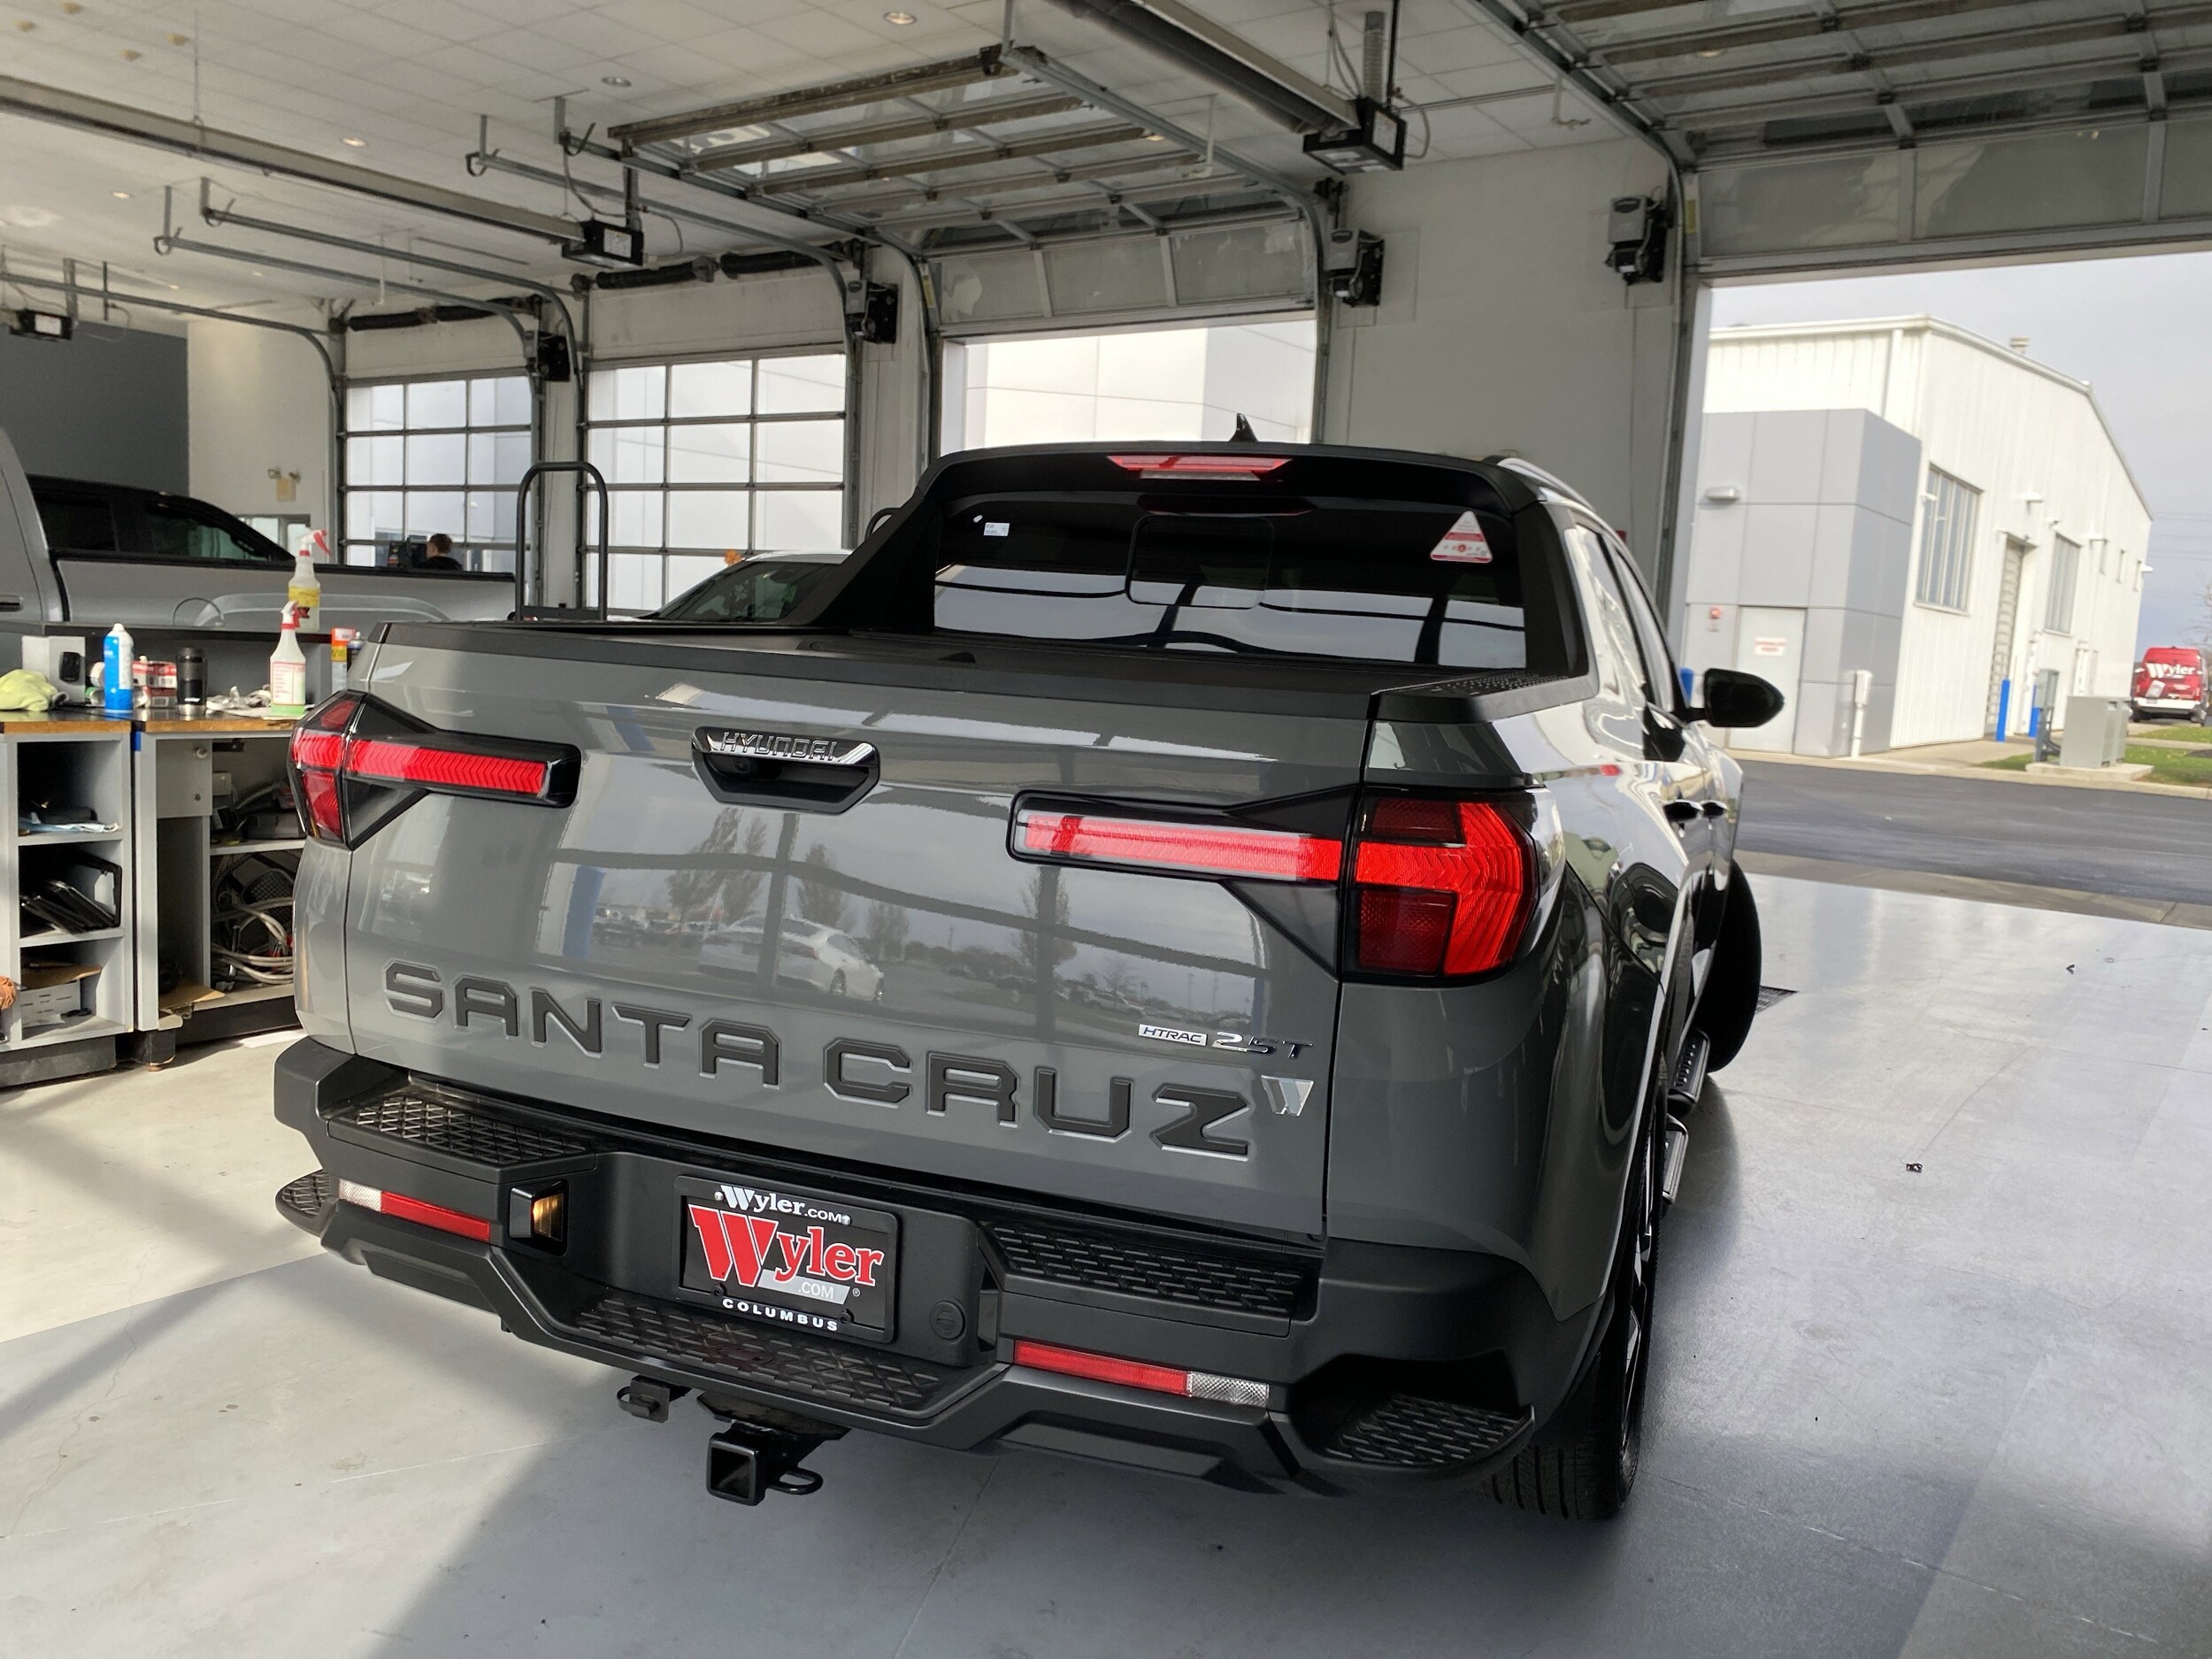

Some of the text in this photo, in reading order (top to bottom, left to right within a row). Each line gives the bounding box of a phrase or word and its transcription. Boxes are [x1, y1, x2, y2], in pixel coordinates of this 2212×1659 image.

[2146, 663, 2196, 679] Wyler
[720, 732, 837, 761] HYUNDAI
[1142, 1026, 1202, 1044] HTRAC
[384, 960, 1251, 1162] SANTA CRUZ
[688, 1204, 885, 1287] Wyler
[798, 1281, 834, 1300] .COM
[722, 1298, 838, 1332] COLUMBUS
